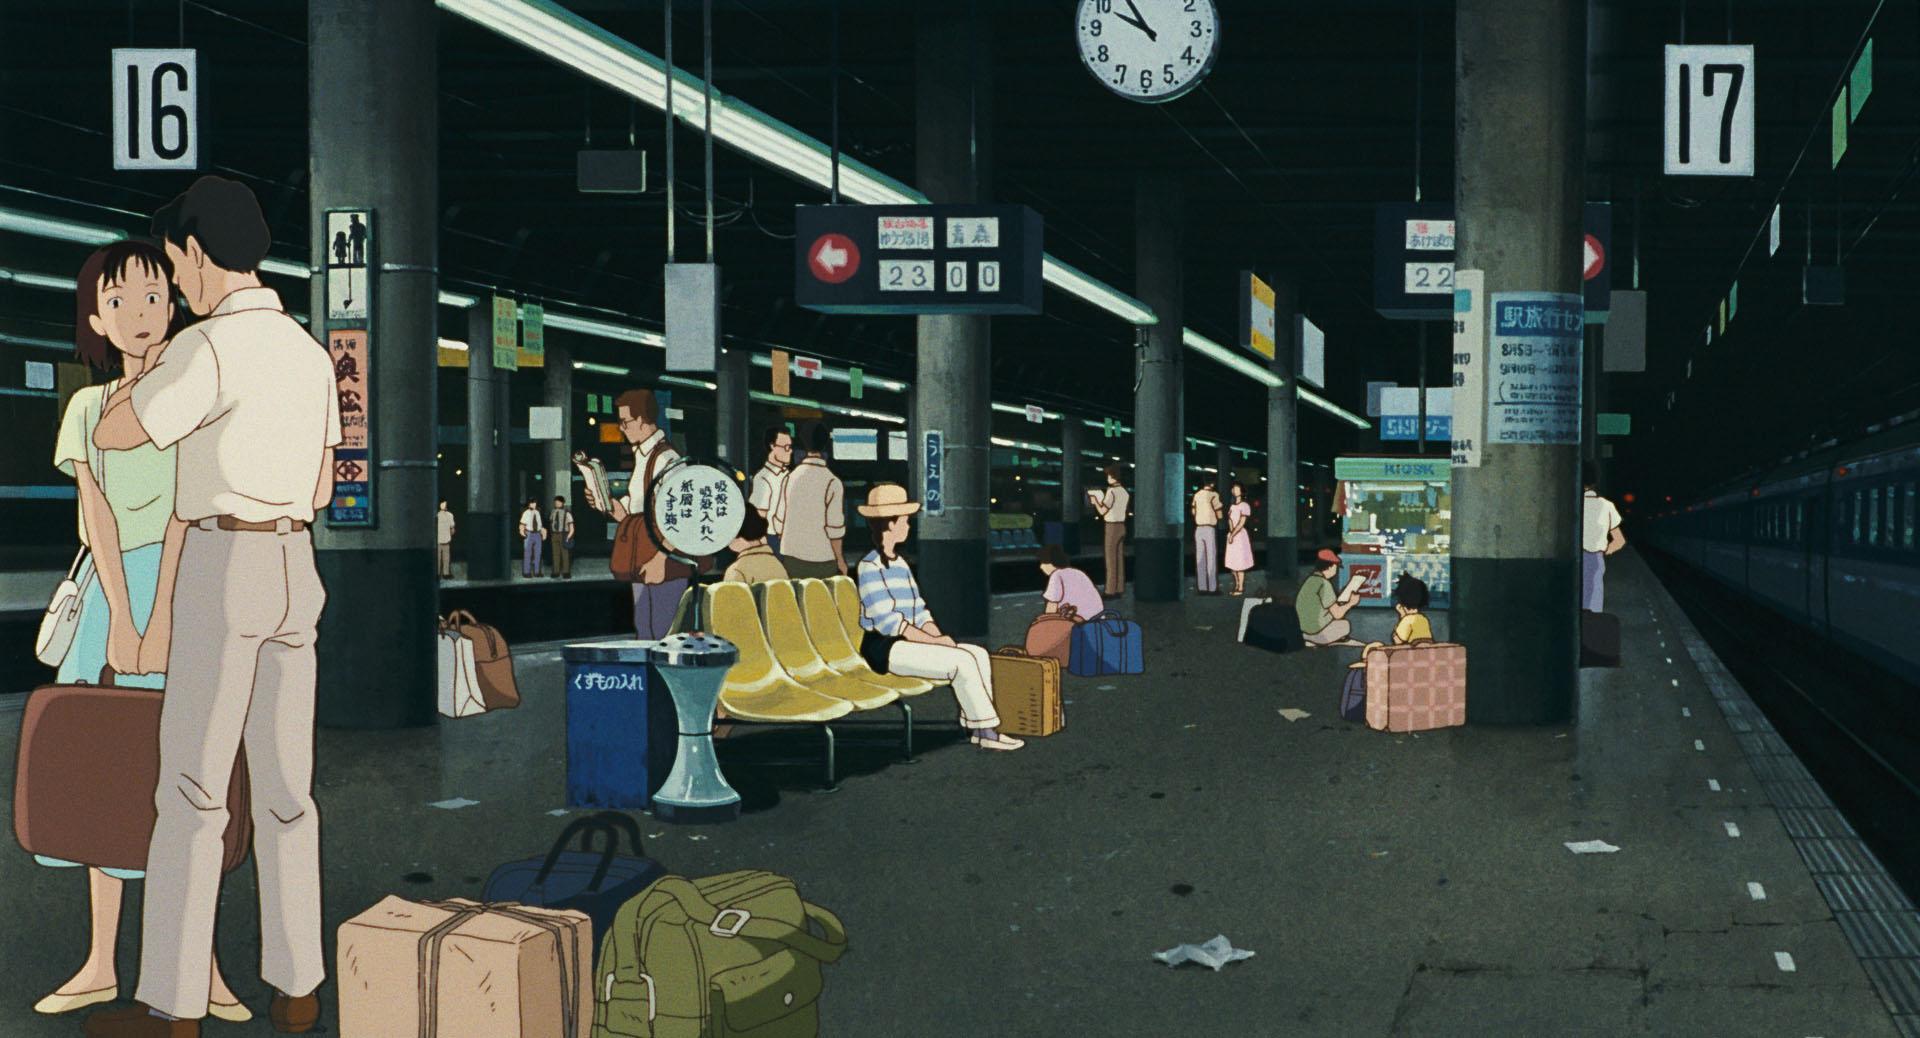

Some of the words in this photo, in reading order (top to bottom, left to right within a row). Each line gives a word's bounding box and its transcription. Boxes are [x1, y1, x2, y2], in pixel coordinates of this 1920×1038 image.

[1090, 19, 1102, 37] 9
[1190, 20, 1202, 37] 3
[1098, 44, 1109, 62] 8
[1180, 45, 1195, 65] 4
[1115, 64, 1127, 84] 7
[1140, 69, 1152, 88] 6
[1163, 64, 1174, 83] 5
[127, 62, 188, 160] 16
[1679, 63, 1745, 164] 17
[952, 223, 991, 244] 青森
[889, 265, 927, 287] 23
[950, 266, 963, 288] 0
[983, 265, 996, 287] 0
[1415, 267, 1453, 287] 22
[927, 440, 940, 501] うえの
[1384, 464, 1434, 475] KIOSK
[574, 672, 643, 690] くずもの入れ
